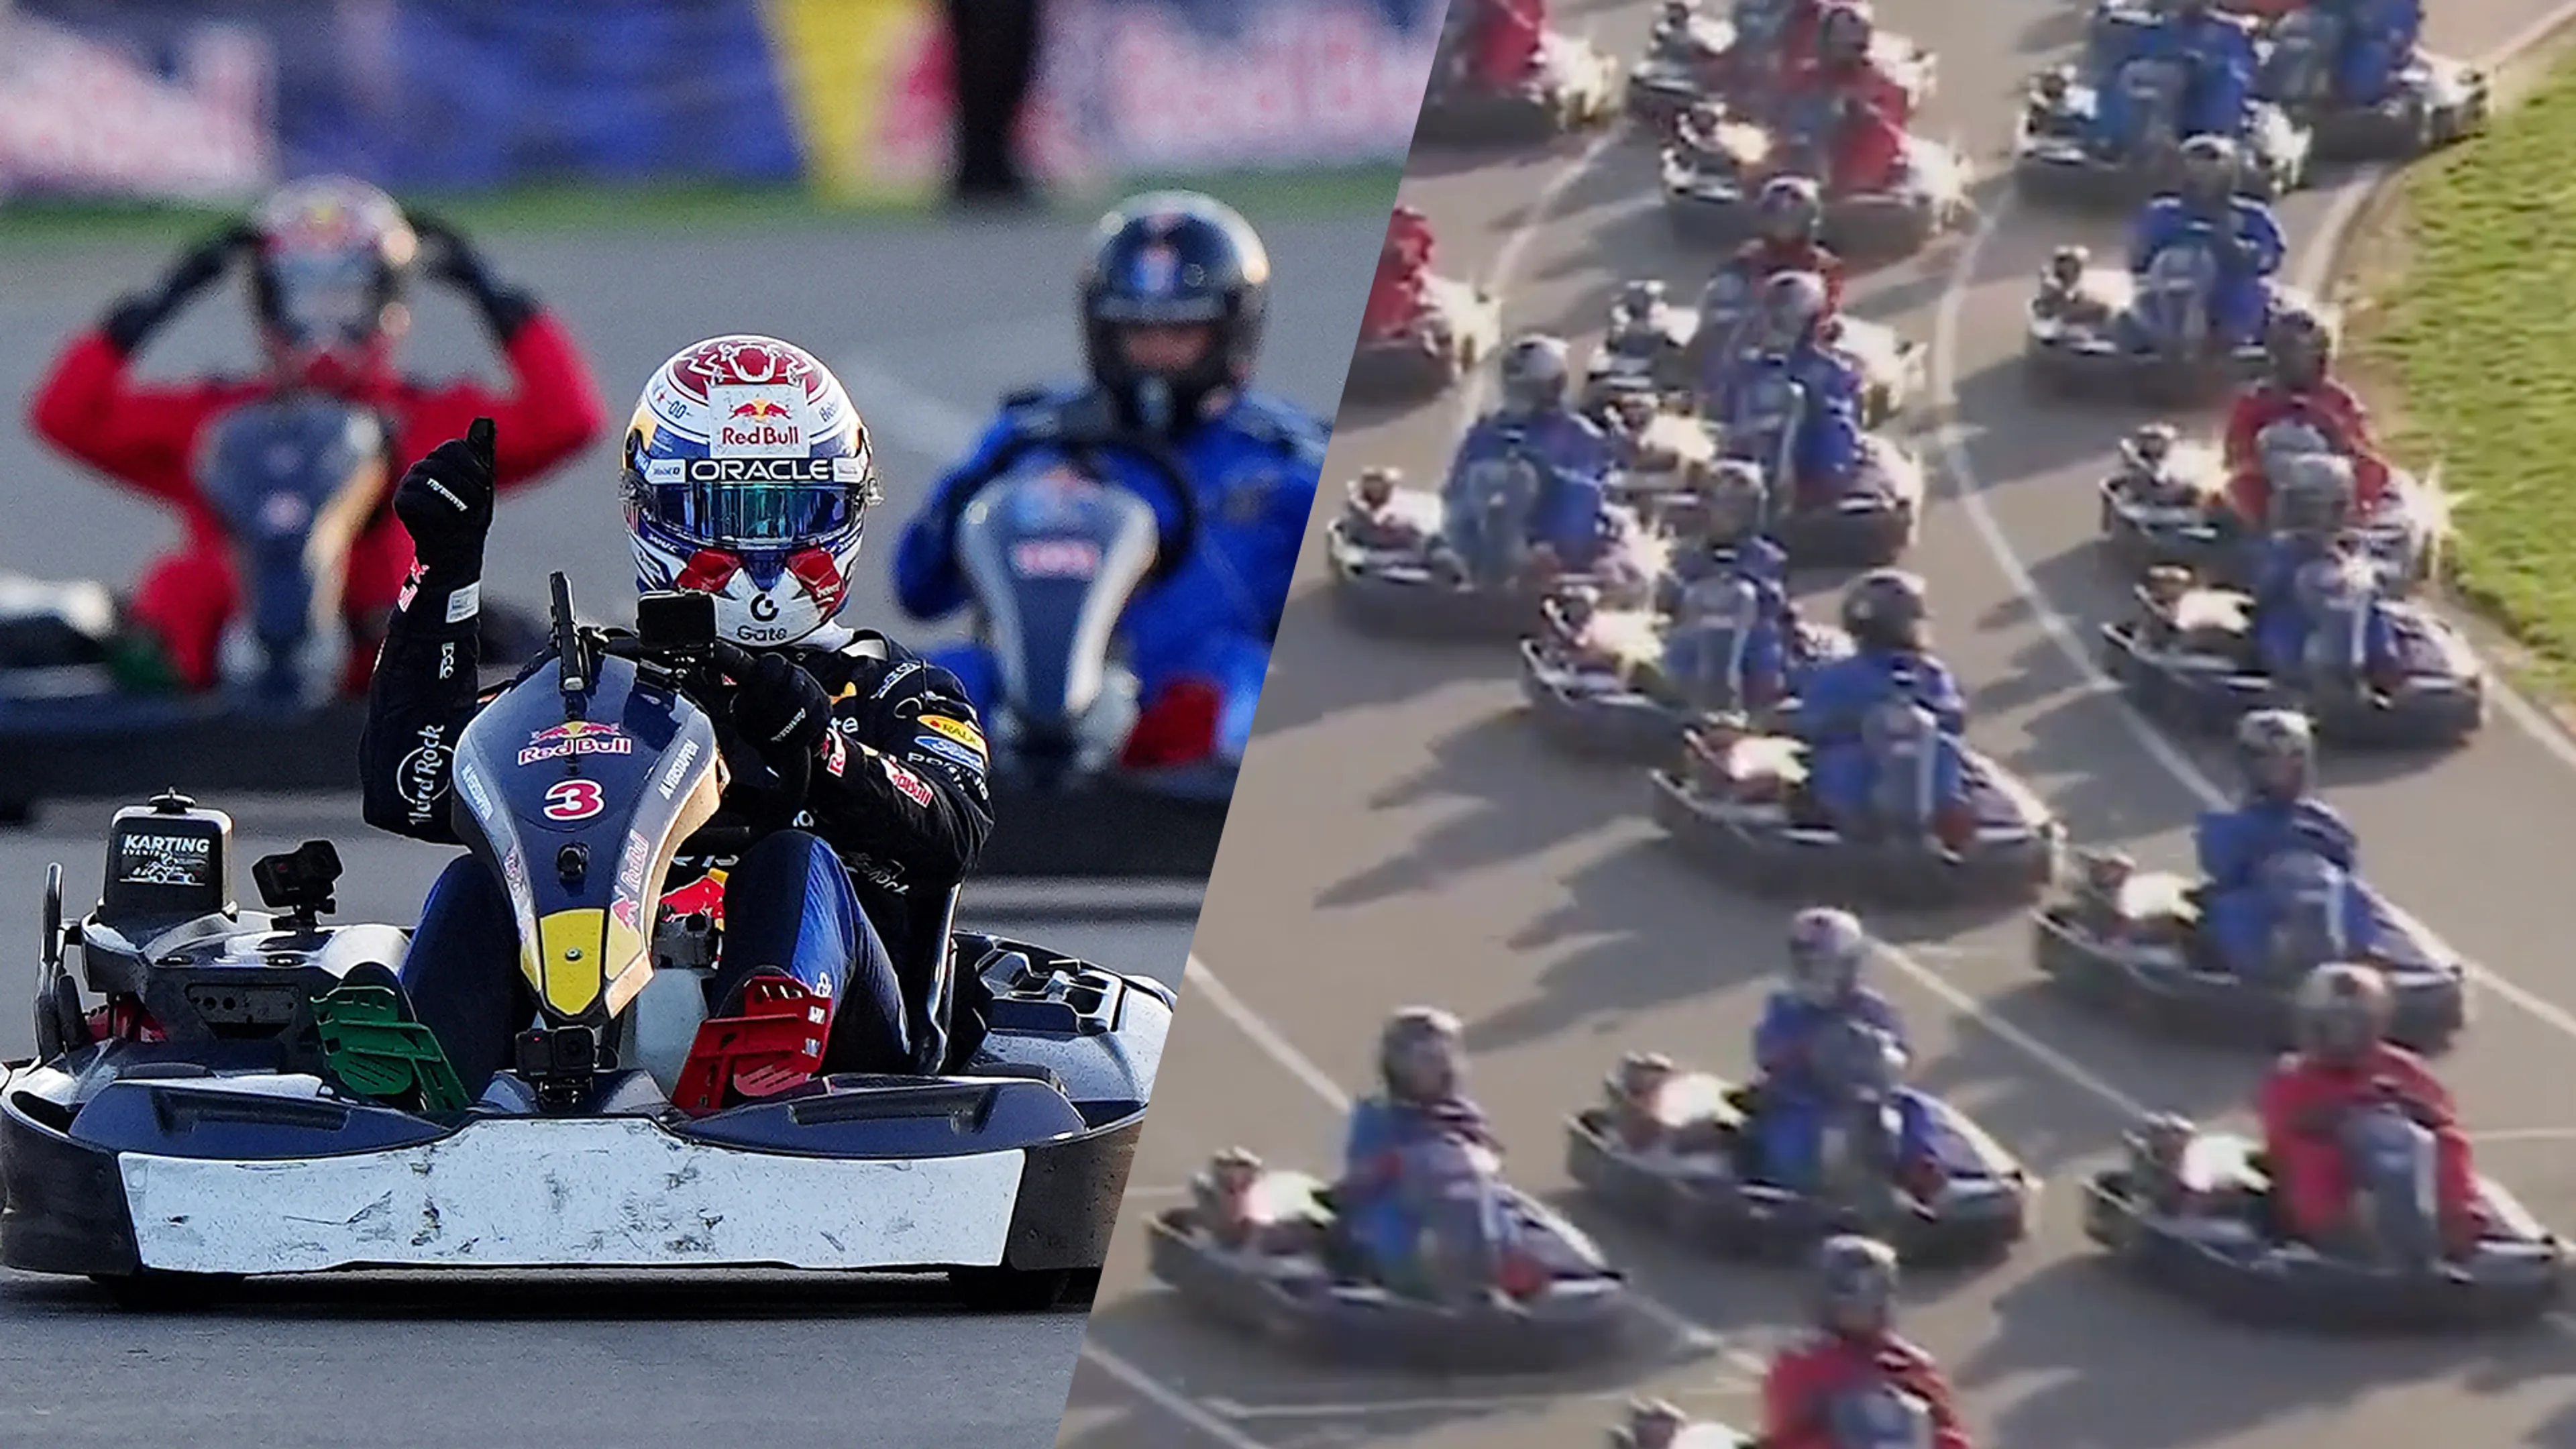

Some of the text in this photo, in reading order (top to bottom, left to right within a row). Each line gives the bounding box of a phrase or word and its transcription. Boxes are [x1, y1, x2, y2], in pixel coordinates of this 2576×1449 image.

[722, 426, 798, 445] Red Bull
[691, 460, 830, 480] ORACLE
[737, 625, 787, 641] Gate
[518, 738, 632, 766] Red Bull
[408, 724, 445, 826] Hard Rock
[543, 779, 604, 821] 3
[125, 834, 210, 853] KARTING
